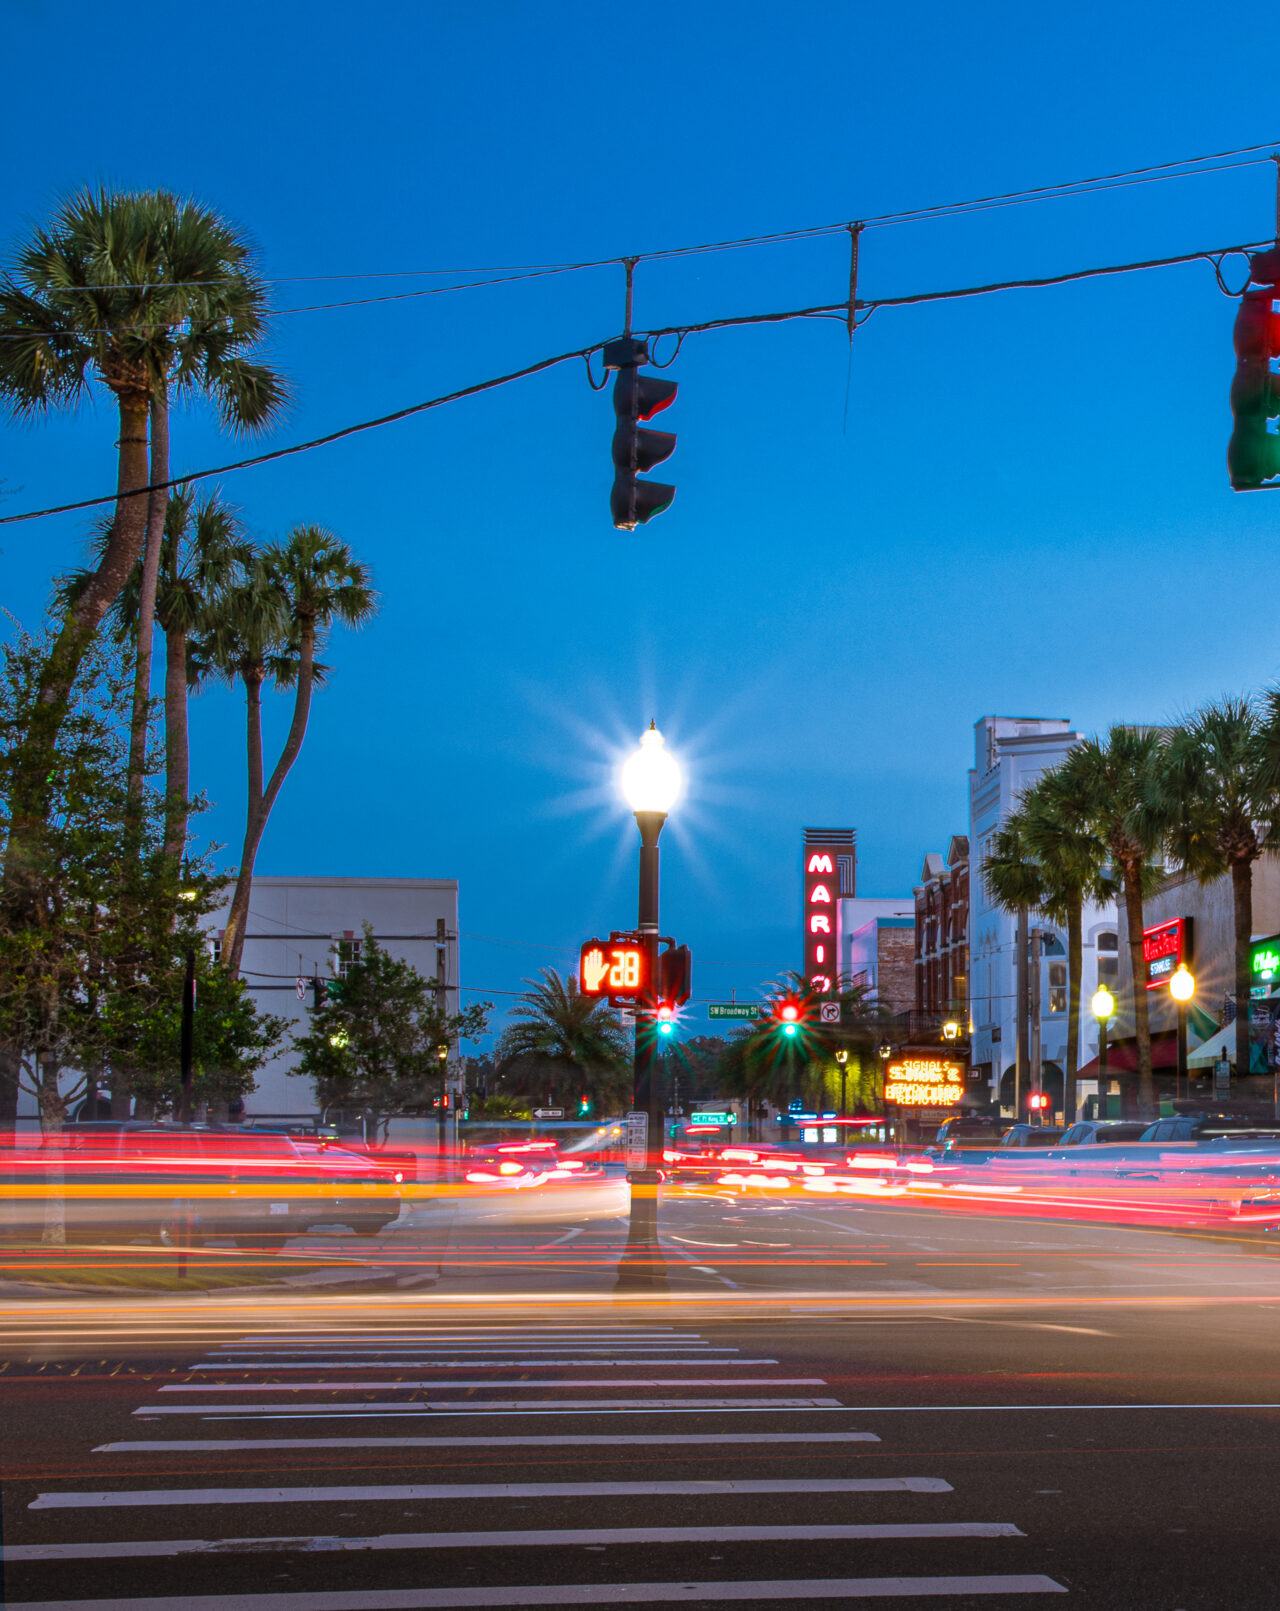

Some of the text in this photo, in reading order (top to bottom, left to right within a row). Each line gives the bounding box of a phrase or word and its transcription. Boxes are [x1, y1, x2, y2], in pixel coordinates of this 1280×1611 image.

[710, 1006, 757, 1017] SW Broadway St
